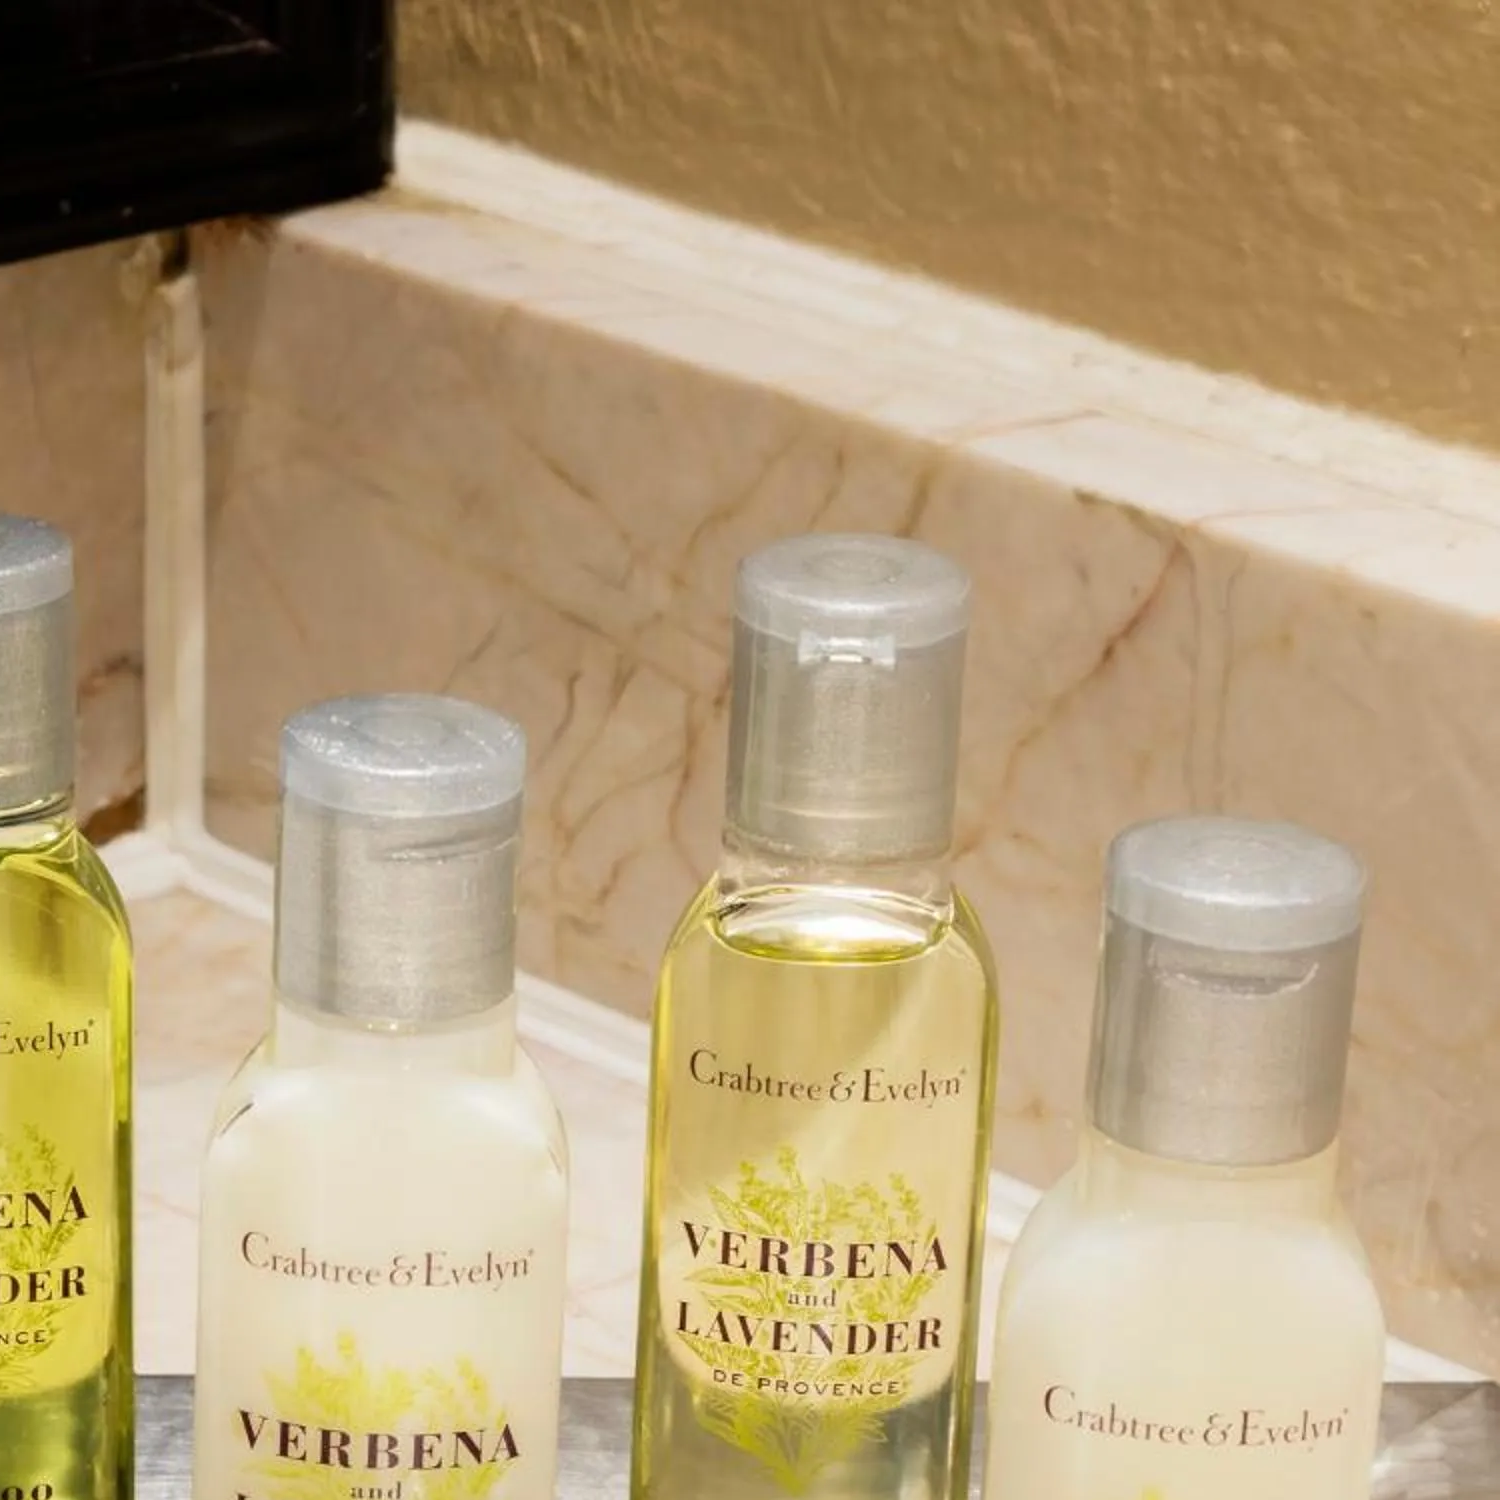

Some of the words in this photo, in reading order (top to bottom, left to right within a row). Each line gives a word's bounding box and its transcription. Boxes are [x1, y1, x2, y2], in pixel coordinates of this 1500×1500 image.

[689, 1049, 822, 1101] Crabtree
[829, 1071, 856, 1102] &
[241, 1231, 382, 1287] Crabtree
[389, 1254, 417, 1287] &
[681, 1221, 948, 1279] VERBENA
[788, 1289, 836, 1308] and
[675, 1301, 942, 1355] LAVENDER
[713, 1369, 744, 1386] DE
[757, 1377, 900, 1396] PROVENCE
[238, 1409, 520, 1471] VERBENA
[1043, 1384, 1194, 1445] Crabtree
[1202, 1412, 1232, 1446] &
[350, 1481, 401, 1500] and
